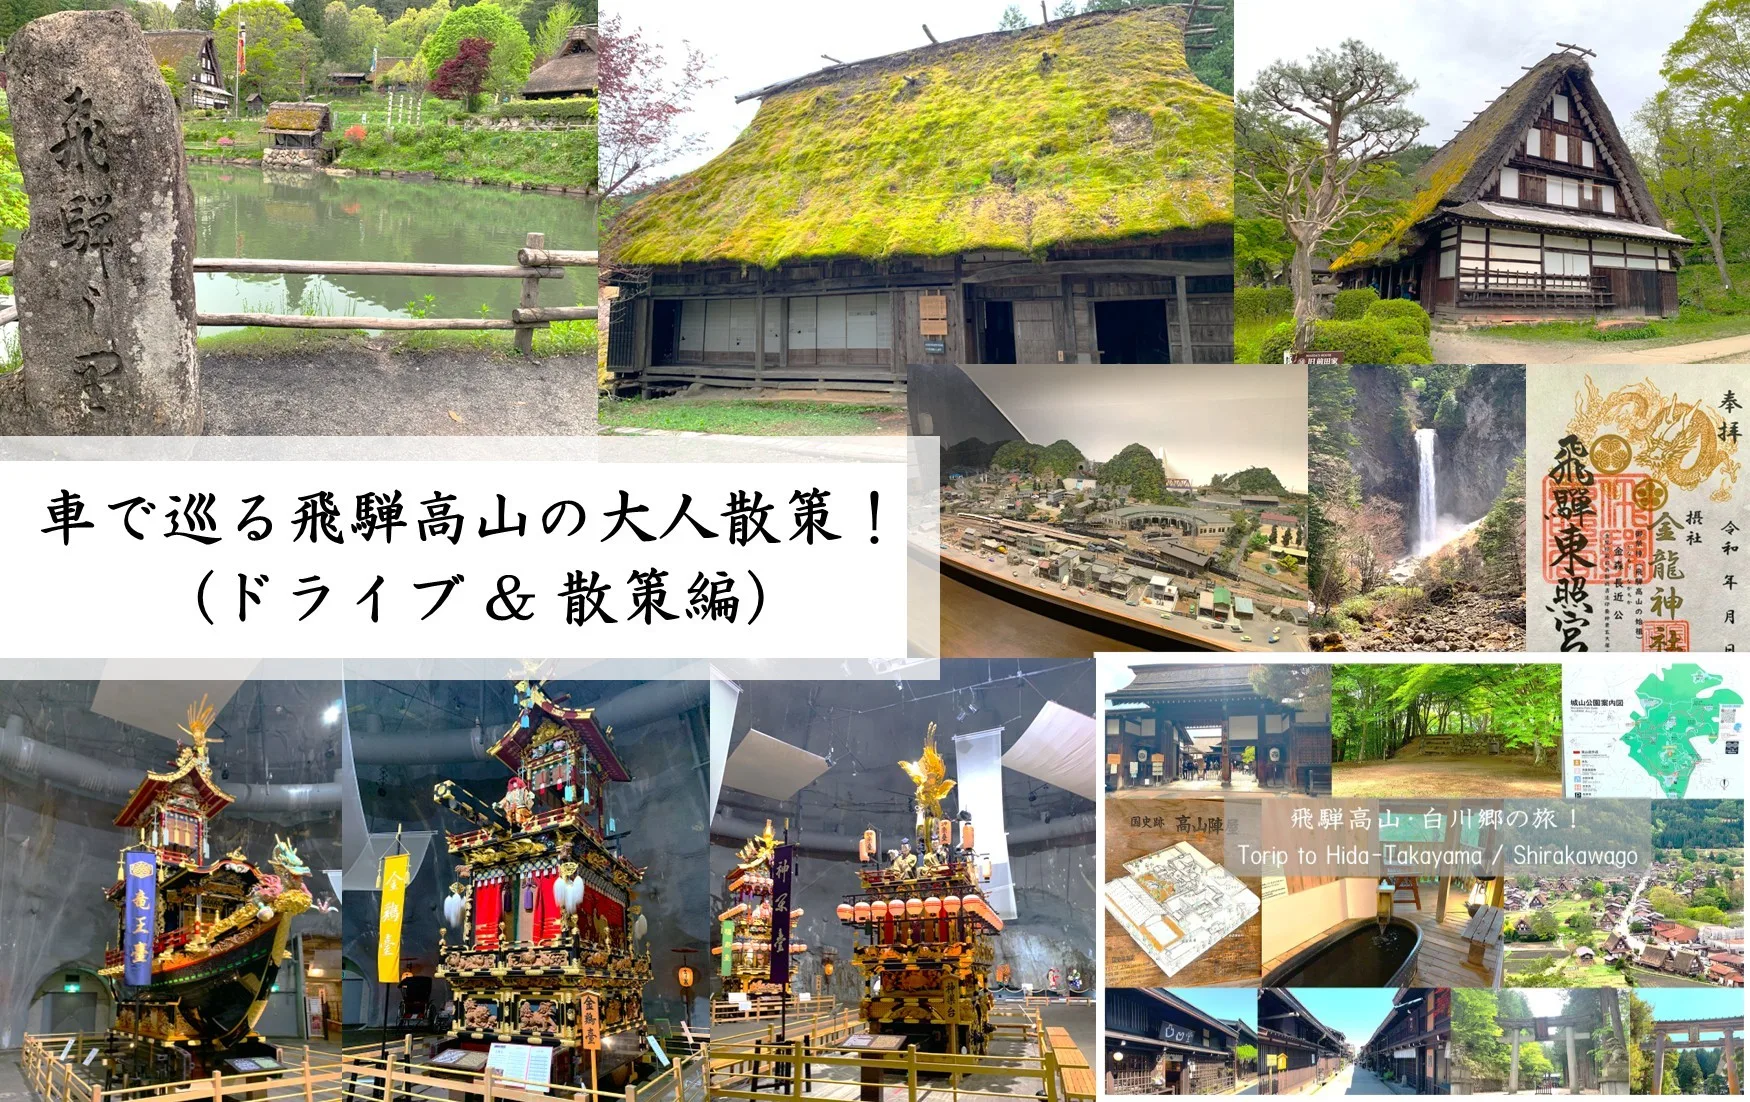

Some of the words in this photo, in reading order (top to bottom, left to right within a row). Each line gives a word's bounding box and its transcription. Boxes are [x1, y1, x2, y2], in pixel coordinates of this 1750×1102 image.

[1717, 389, 1743, 445] 奉拝
[1685, 510, 1704, 546] 摂社
[1720, 520, 1740, 556] 令和
[1646, 511, 1685, 652] 金龍神社
[1570, 699, 1624, 707] 城山公園案内図
[1130, 815, 1165, 829] 国史跡
[1175, 815, 1240, 836] 高山陣屋
